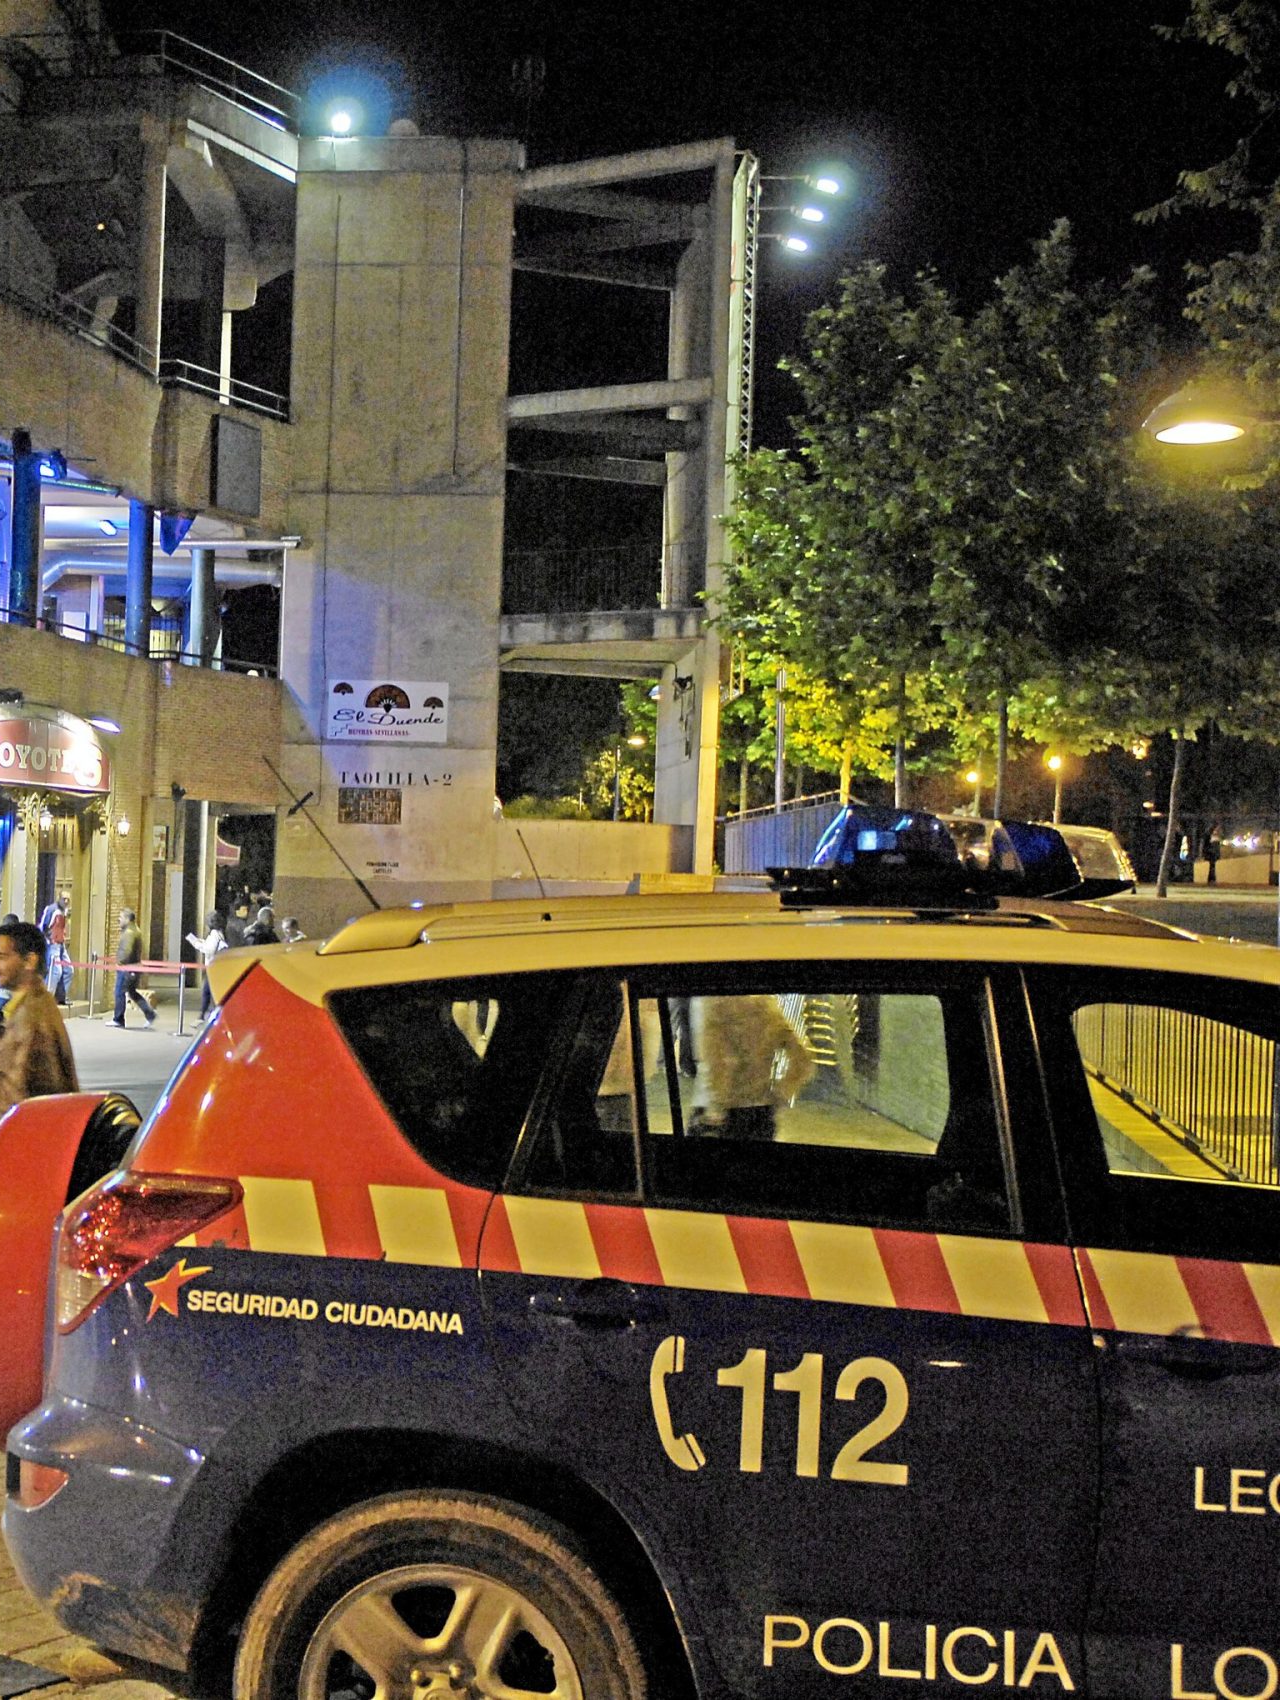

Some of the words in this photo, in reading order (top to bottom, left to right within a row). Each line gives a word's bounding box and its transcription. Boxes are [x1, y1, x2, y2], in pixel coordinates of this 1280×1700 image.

[333, 708, 365, 723] El
[367, 712, 444, 726] Duende
[187, 1289, 319, 1321] SEGURIDAD
[324, 1301, 464, 1335] CIUDADANA
[716, 1347, 910, 1487] 112
[763, 1614, 1075, 1691] POLICIA
